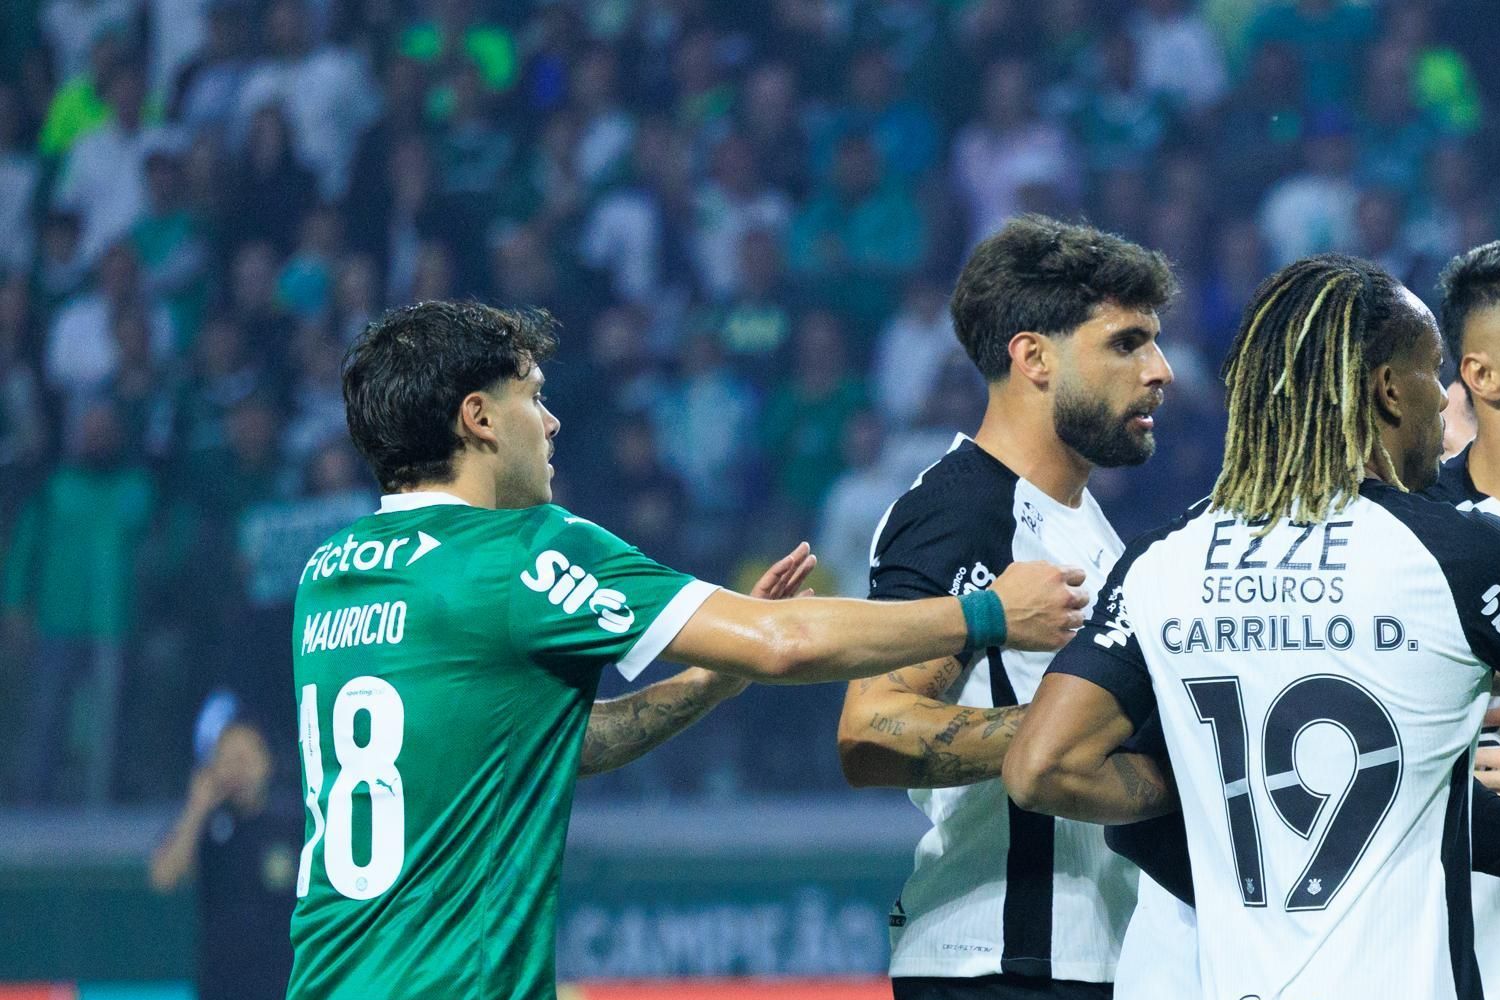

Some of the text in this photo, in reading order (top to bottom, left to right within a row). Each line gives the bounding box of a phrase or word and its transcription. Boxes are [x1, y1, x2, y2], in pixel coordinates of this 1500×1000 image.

[300, 533, 409, 585] Fictor
[1204, 519, 1353, 571] EZZE
[1201, 574, 1345, 604] SEGUROS
[301, 599, 407, 656] MAURICIO
[1161, 614, 1354, 653] CARRILLO
[1373, 615, 1418, 652] D.
[296, 675, 405, 901] 18
[1180, 673, 1404, 913] 19
